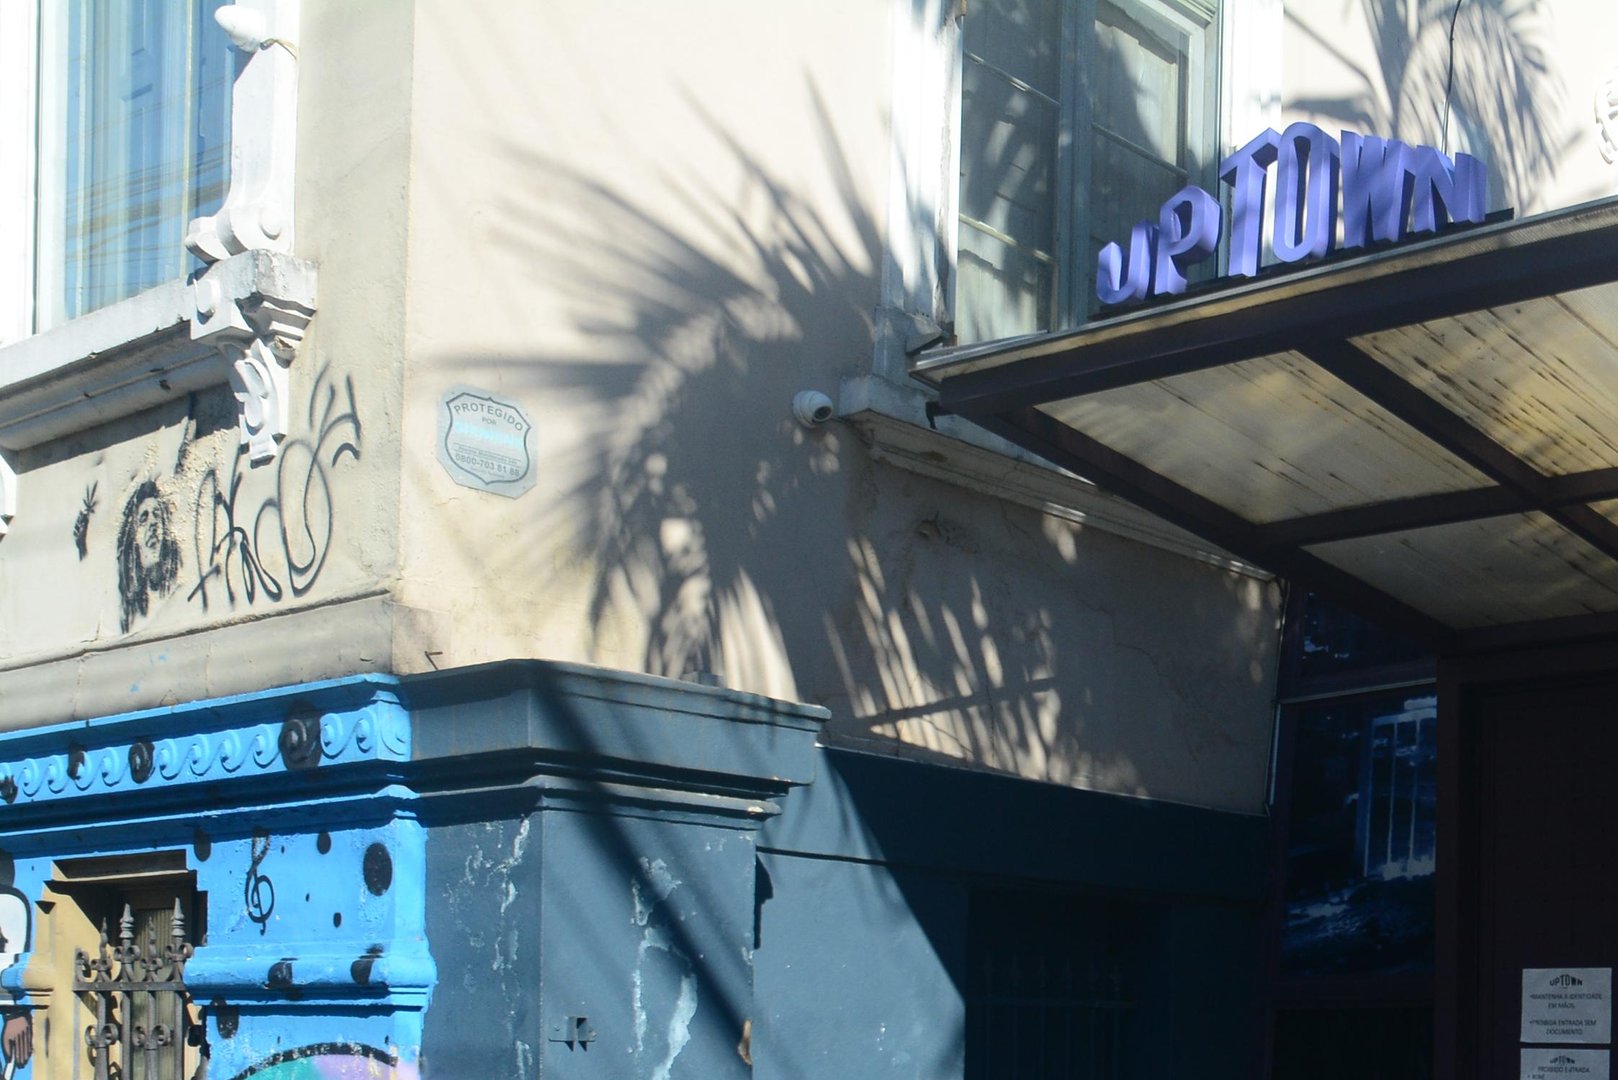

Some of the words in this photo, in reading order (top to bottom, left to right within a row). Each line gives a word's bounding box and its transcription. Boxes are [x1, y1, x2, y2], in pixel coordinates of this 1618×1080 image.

[1096, 121, 1487, 304] UPTOWN
[453, 402, 523, 432] PROTEGIDO
[481, 416, 497, 426] POR
[455, 453, 495, 470] 0800-703
[1549, 974, 1583, 987] UPTOWN
[1549, 1055, 1576, 1065] UPTOWN
